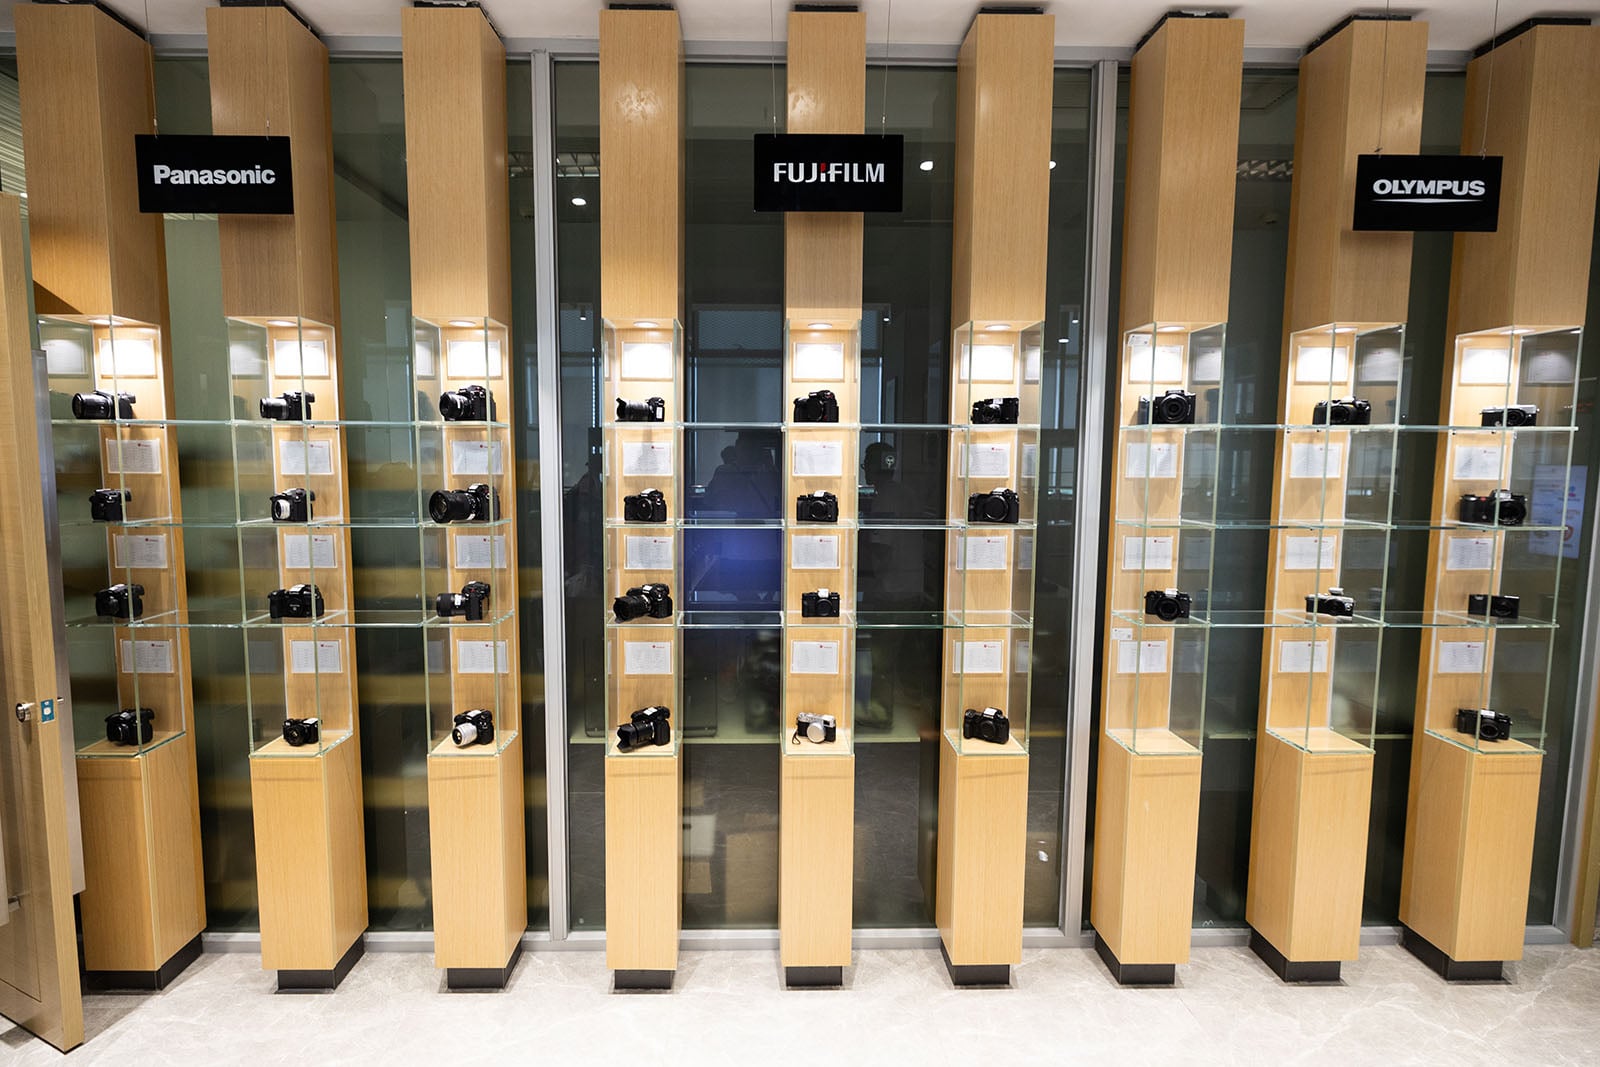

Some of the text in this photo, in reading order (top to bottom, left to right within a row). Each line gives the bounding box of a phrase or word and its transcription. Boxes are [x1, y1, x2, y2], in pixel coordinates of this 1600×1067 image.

[153, 164, 276, 186] Panasonic
[773, 162, 885, 183] FUJIFILM
[1373, 179, 1486, 196] OLYMPUS
